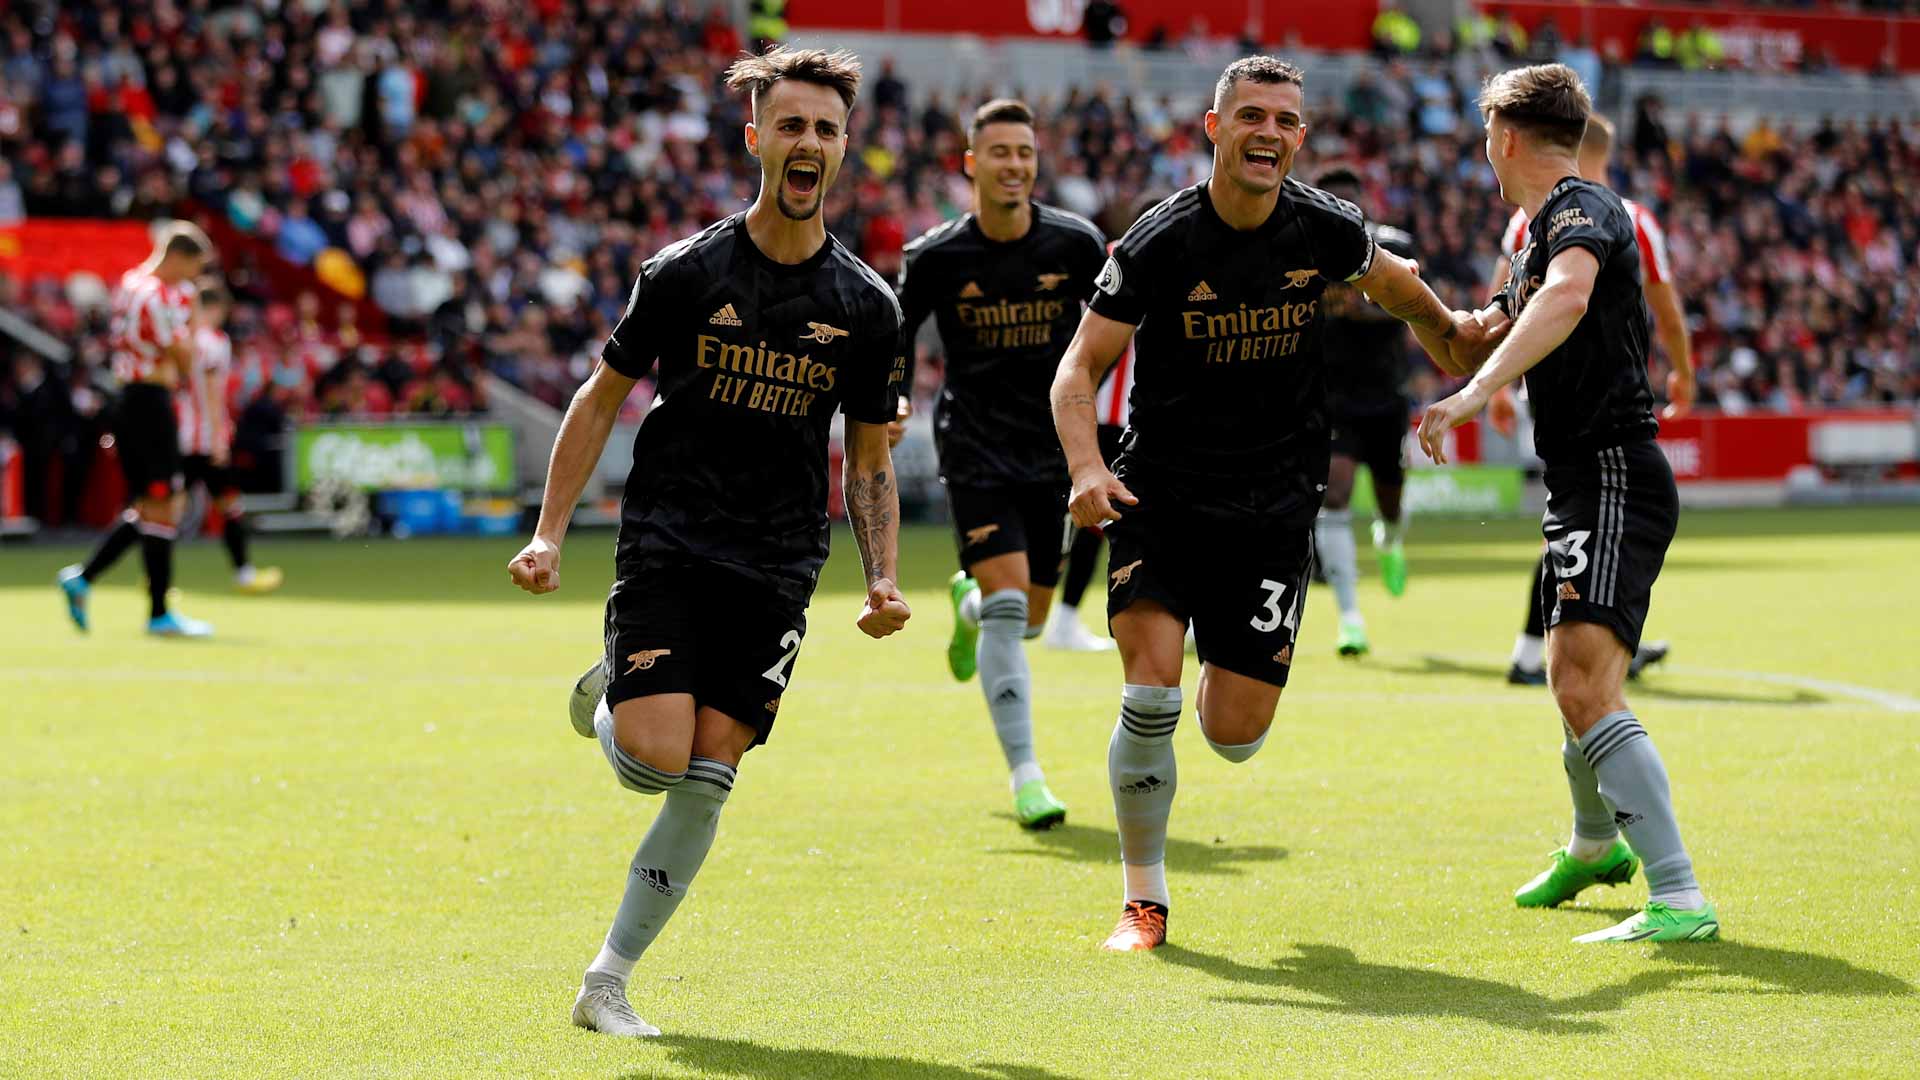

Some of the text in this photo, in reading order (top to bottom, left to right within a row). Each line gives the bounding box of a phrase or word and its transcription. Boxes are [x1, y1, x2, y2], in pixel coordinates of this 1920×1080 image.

[1552, 208, 1582, 224] VISIT
[1188, 292, 1217, 302] adidas
[708, 317, 742, 327] adidas
[956, 298, 1064, 328] Emirates
[1181, 301, 1318, 340] Emirates
[976, 328, 1000, 348] FLY
[1206, 332, 1300, 363] FLY BETTER
[697, 333, 837, 392] Emirates
[709, 374, 816, 417] FLY BETTER
[1560, 530, 1592, 578] 3
[762, 629, 801, 689] 2
[633, 867, 674, 897] adidas
